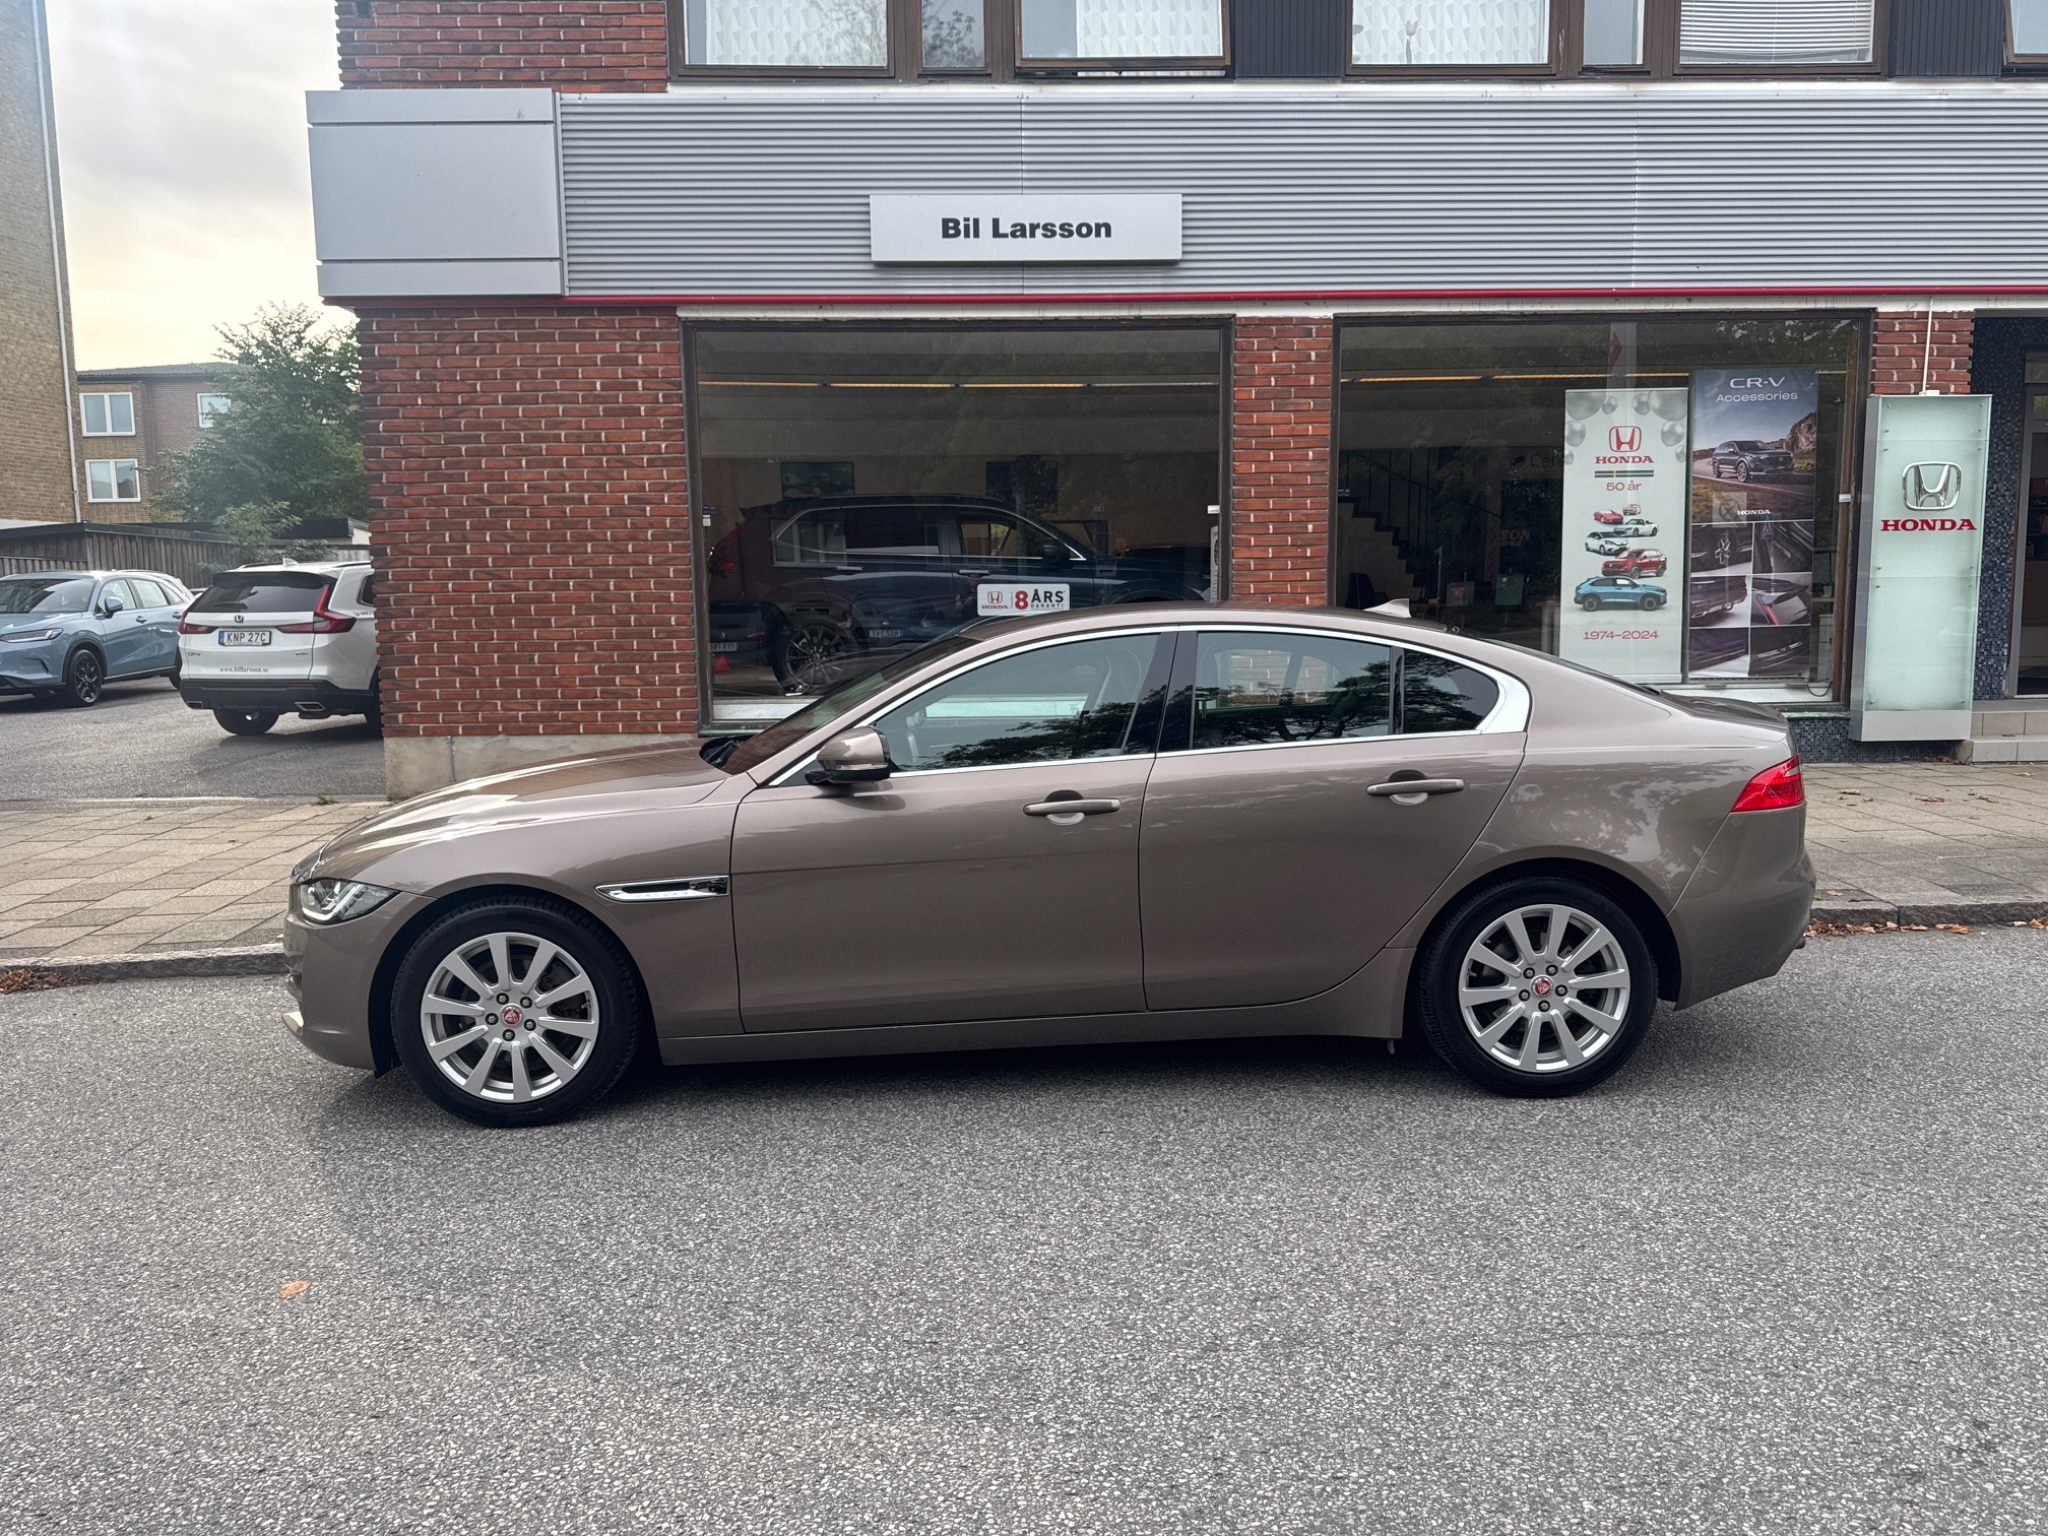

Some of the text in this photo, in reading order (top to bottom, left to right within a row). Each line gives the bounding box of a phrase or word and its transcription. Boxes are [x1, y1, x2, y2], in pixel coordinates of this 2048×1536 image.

[941, 217, 1112, 239] Bil Larsson
[1729, 376, 1785, 389] CR-V
[1715, 391, 1798, 403] Accessories
[1594, 455, 1655, 464] HONDA
[1606, 479, 1642, 491] 50 år
[1736, 508, 1772, 516] HONDA
[1880, 518, 1977, 532] HONDA
[1014, 588, 1064, 610] 8 ÅRS
[226, 632, 266, 642] KNP 27C
